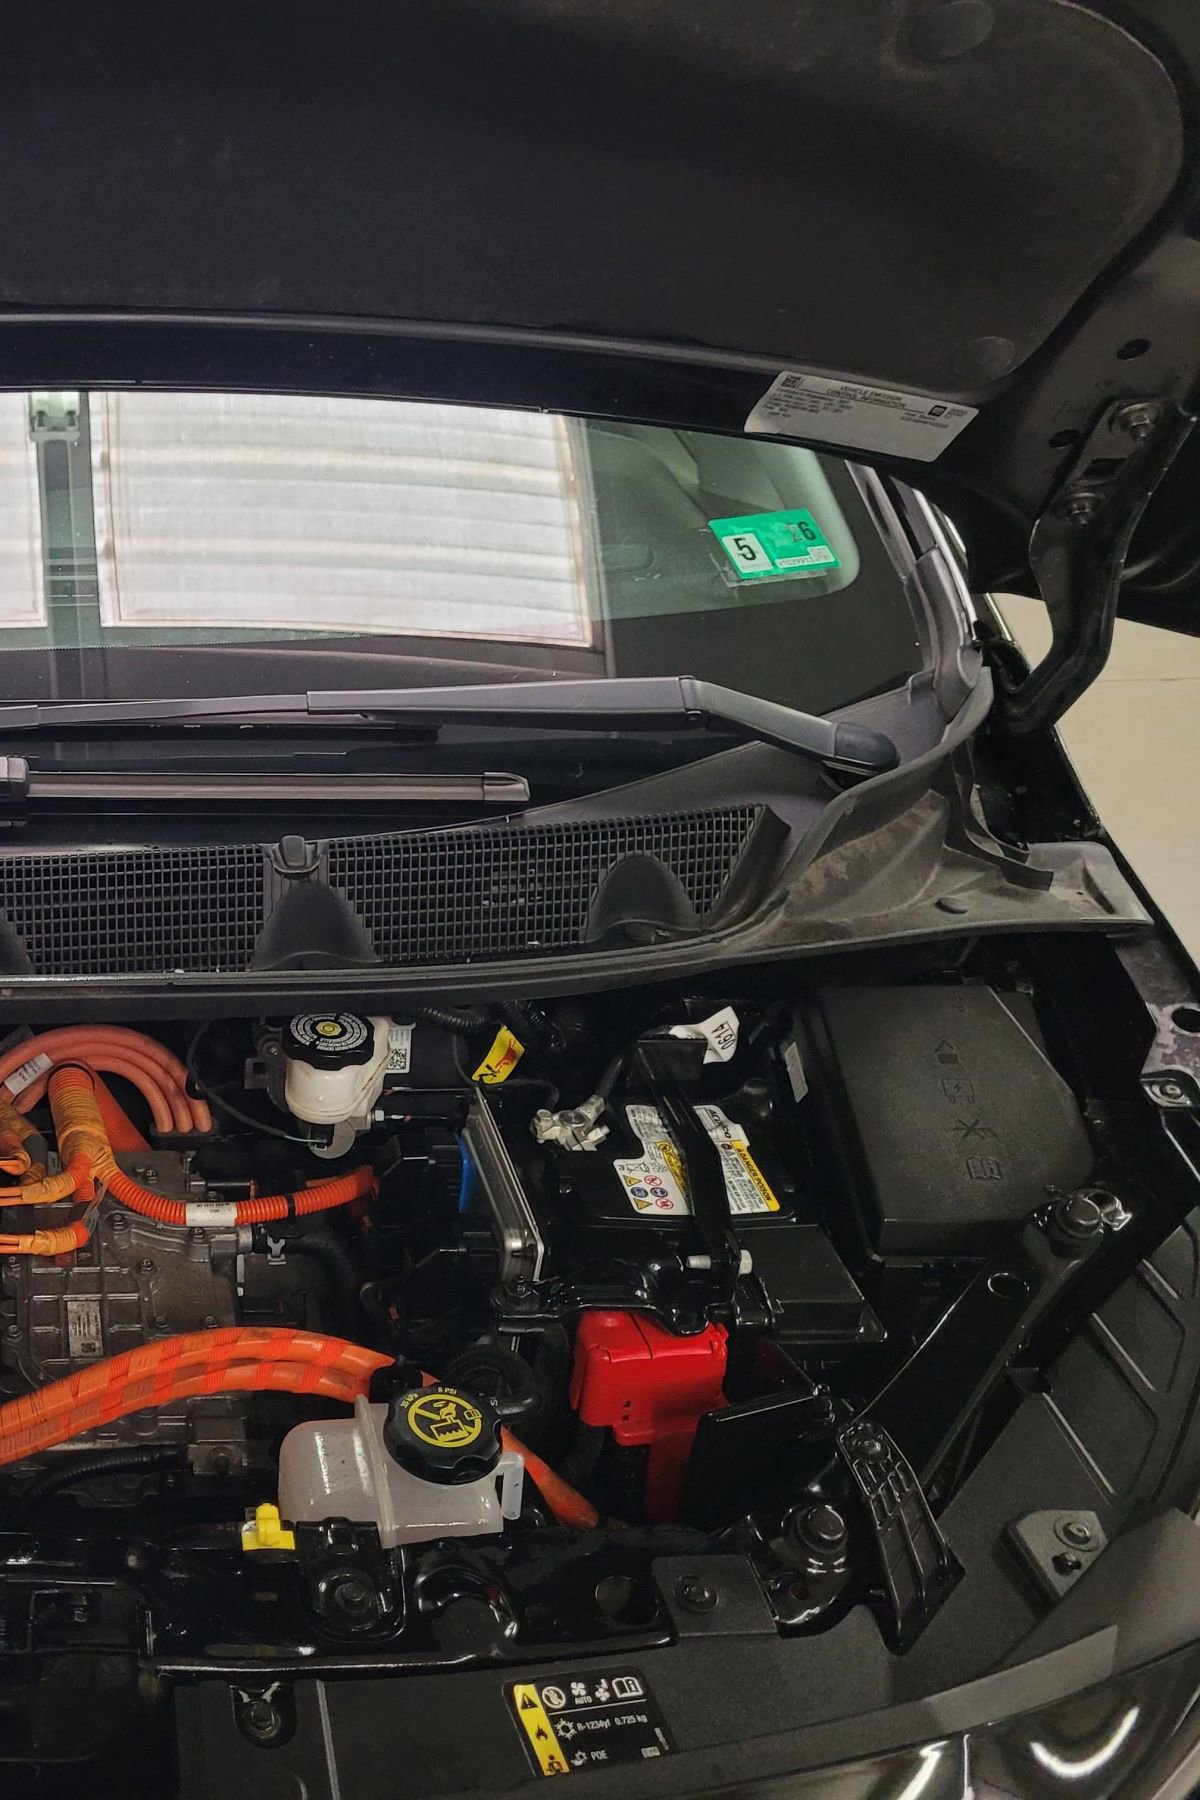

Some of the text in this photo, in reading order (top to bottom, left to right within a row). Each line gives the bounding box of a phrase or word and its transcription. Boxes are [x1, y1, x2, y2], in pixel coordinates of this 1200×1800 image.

[732, 537, 757, 561] 5
[711, 1022, 736, 1050] 0614
[444, 1387, 458, 1395] PSI
[574, 1695, 593, 1705] AUTO
[614, 1715, 636, 1725] 0.725
[637, 1714, 648, 1724] kg
[590, 1750, 609, 1761] POE
